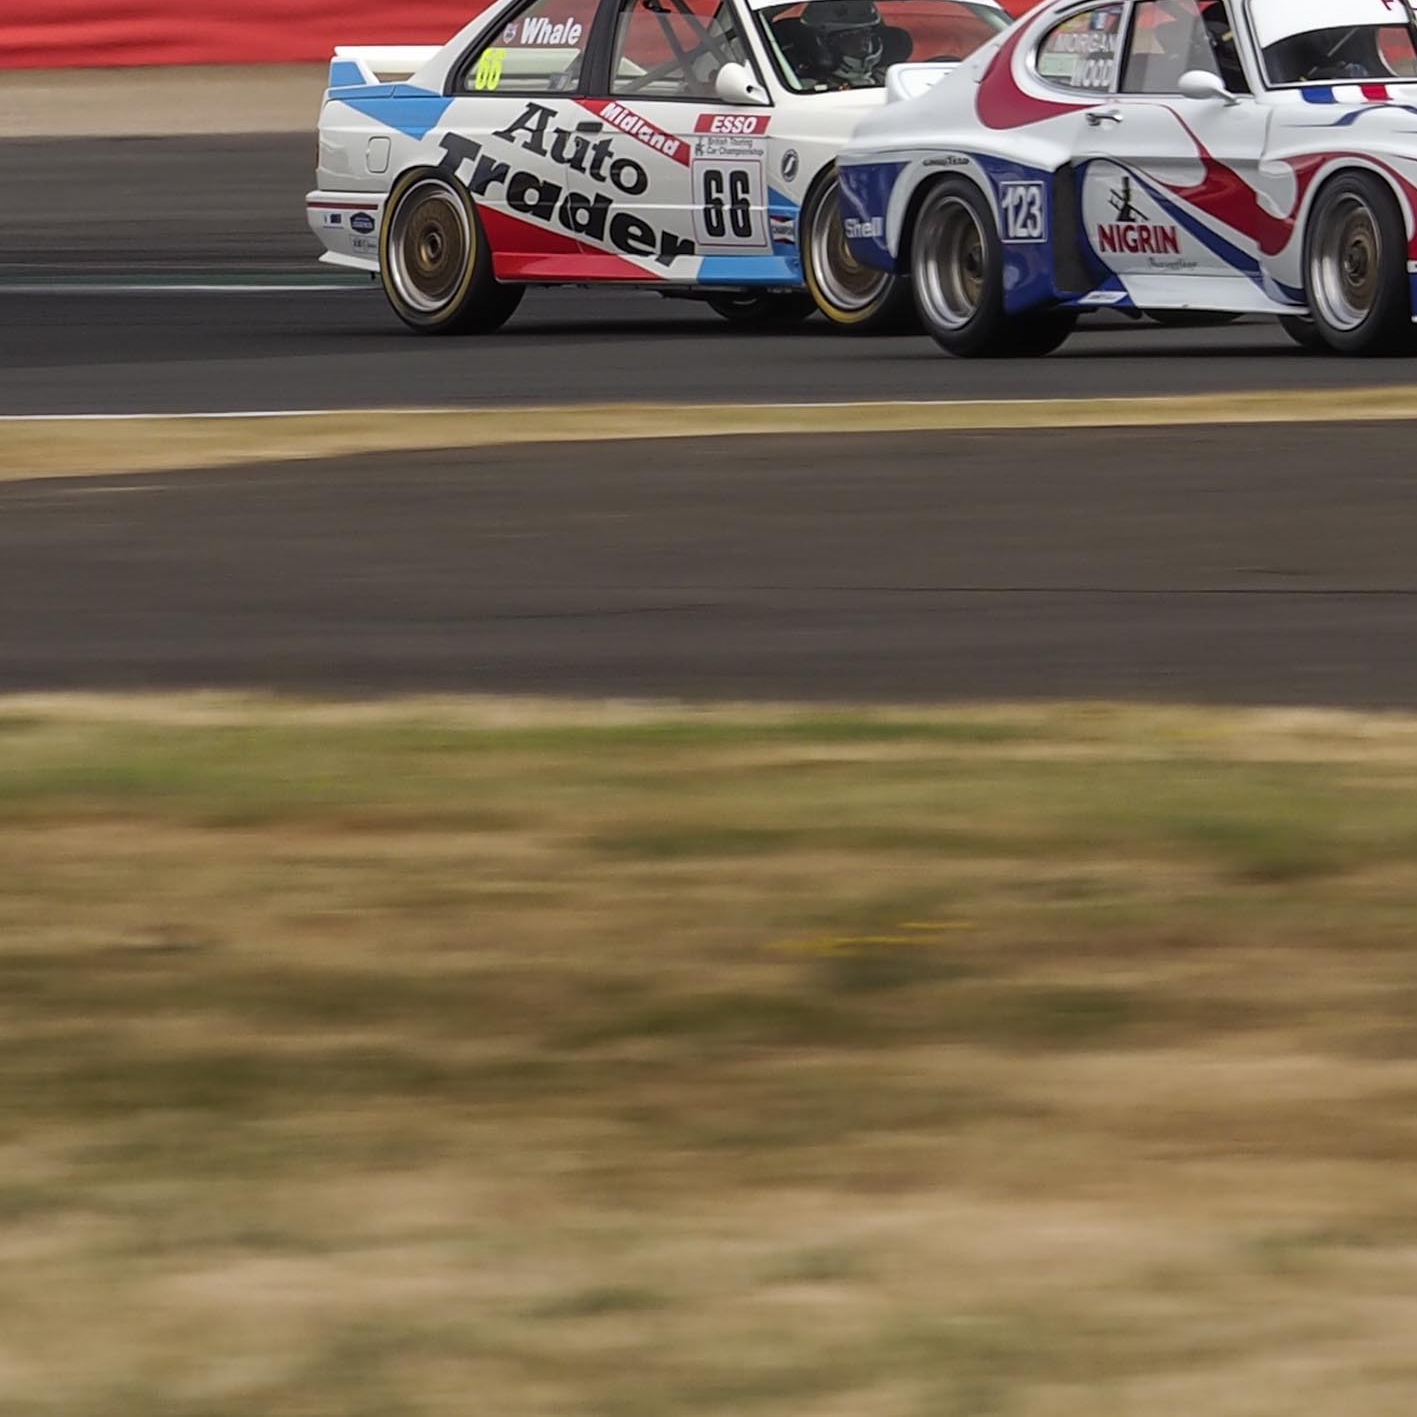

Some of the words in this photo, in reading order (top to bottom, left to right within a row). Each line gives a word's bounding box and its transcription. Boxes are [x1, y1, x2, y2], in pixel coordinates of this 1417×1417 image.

[521, 17, 582, 45] Whale
[475, 48, 507, 90] 66
[492, 101, 649, 195] Auto
[600, 102, 681, 157] Midland
[710, 116, 757, 134] ESSO
[438, 132, 695, 267] Trader
[703, 169, 752, 237] 66
[1002, 186, 1042, 238] 123
[844, 217, 883, 238] Shell
[1097, 224, 1181, 254] NIGRIN
